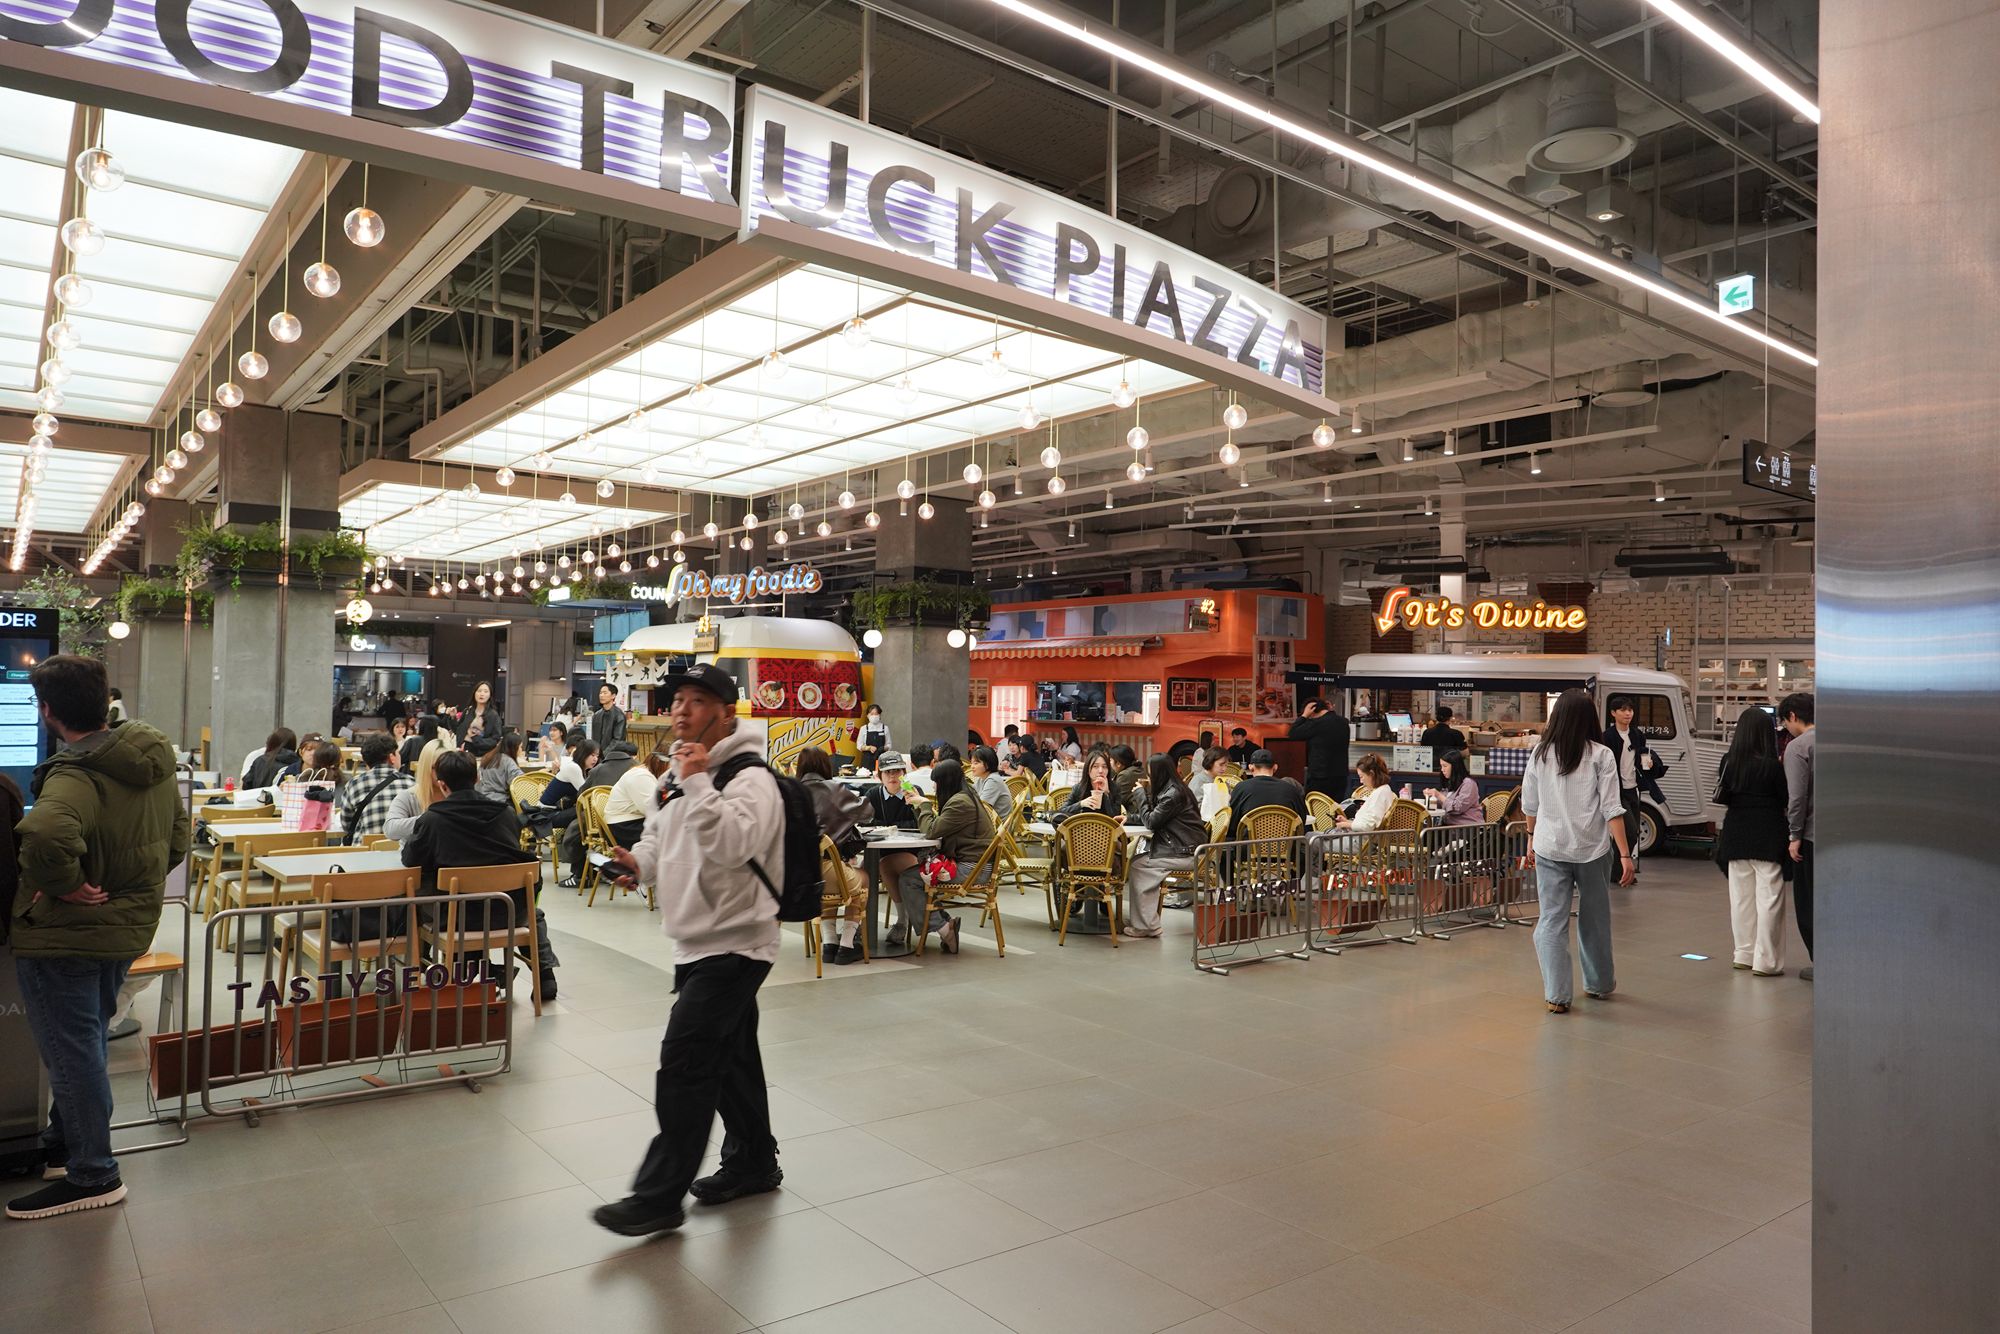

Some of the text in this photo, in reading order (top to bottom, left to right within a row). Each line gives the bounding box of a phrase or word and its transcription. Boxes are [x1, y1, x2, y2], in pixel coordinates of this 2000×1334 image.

[551, 60, 1017, 287] TRUCK
[1054, 221, 1310, 391] PIAZZA
[631, 585, 666, 600] COUN
[679, 564, 822, 604] Oh my foodie
[1201, 598, 1216, 615] #2
[1404, 599, 1587, 629] It's Divine
[1206, 877, 1306, 905] TASTYSEOUL
[227, 959, 498, 1012] TASTYSEOUL
